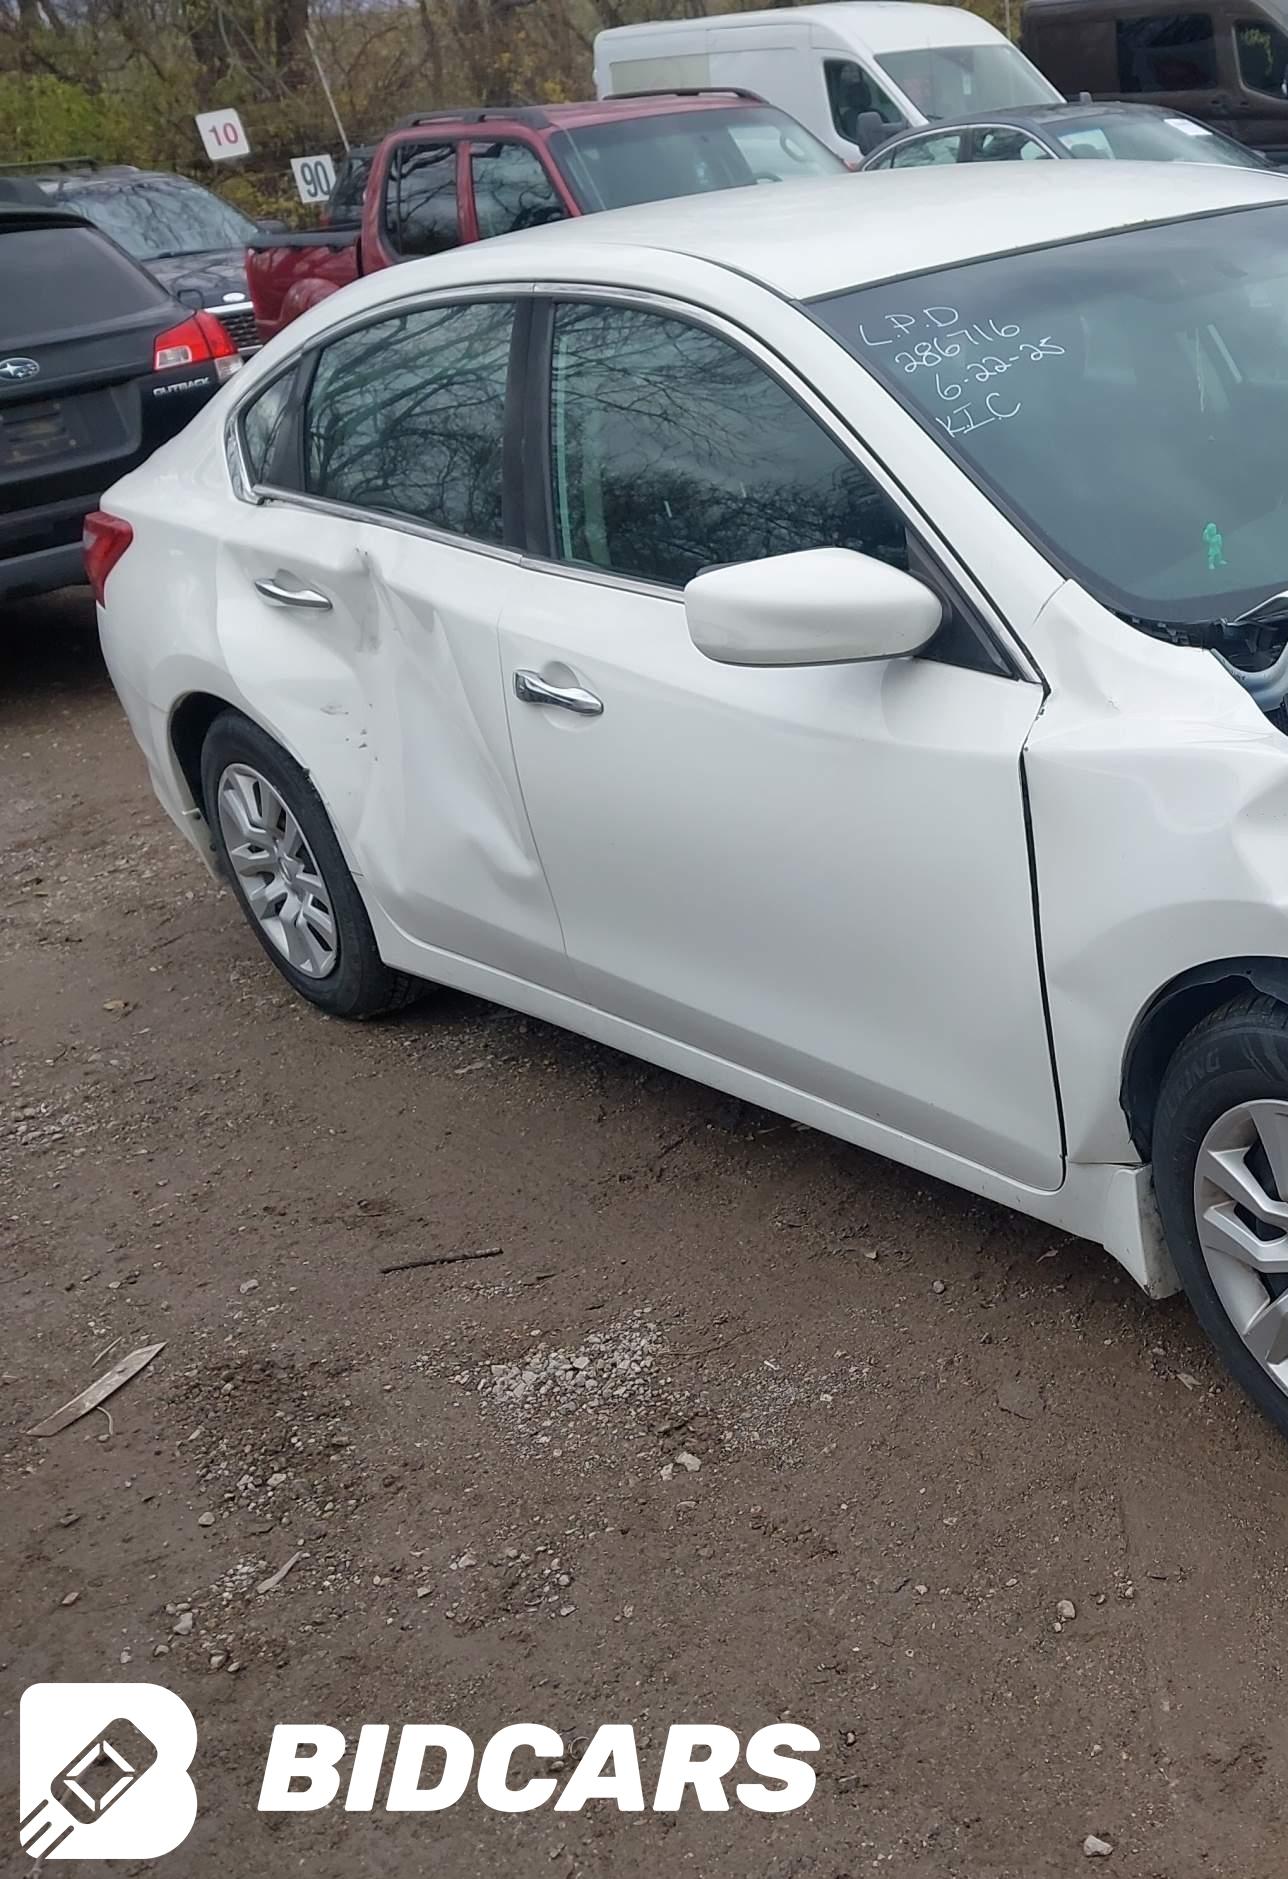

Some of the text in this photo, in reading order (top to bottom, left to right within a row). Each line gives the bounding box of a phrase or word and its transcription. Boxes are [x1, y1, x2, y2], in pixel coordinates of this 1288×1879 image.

[208, 122, 239, 146] 10
[301, 160, 331, 198] 90
[894, 319, 1021, 373] 286716
